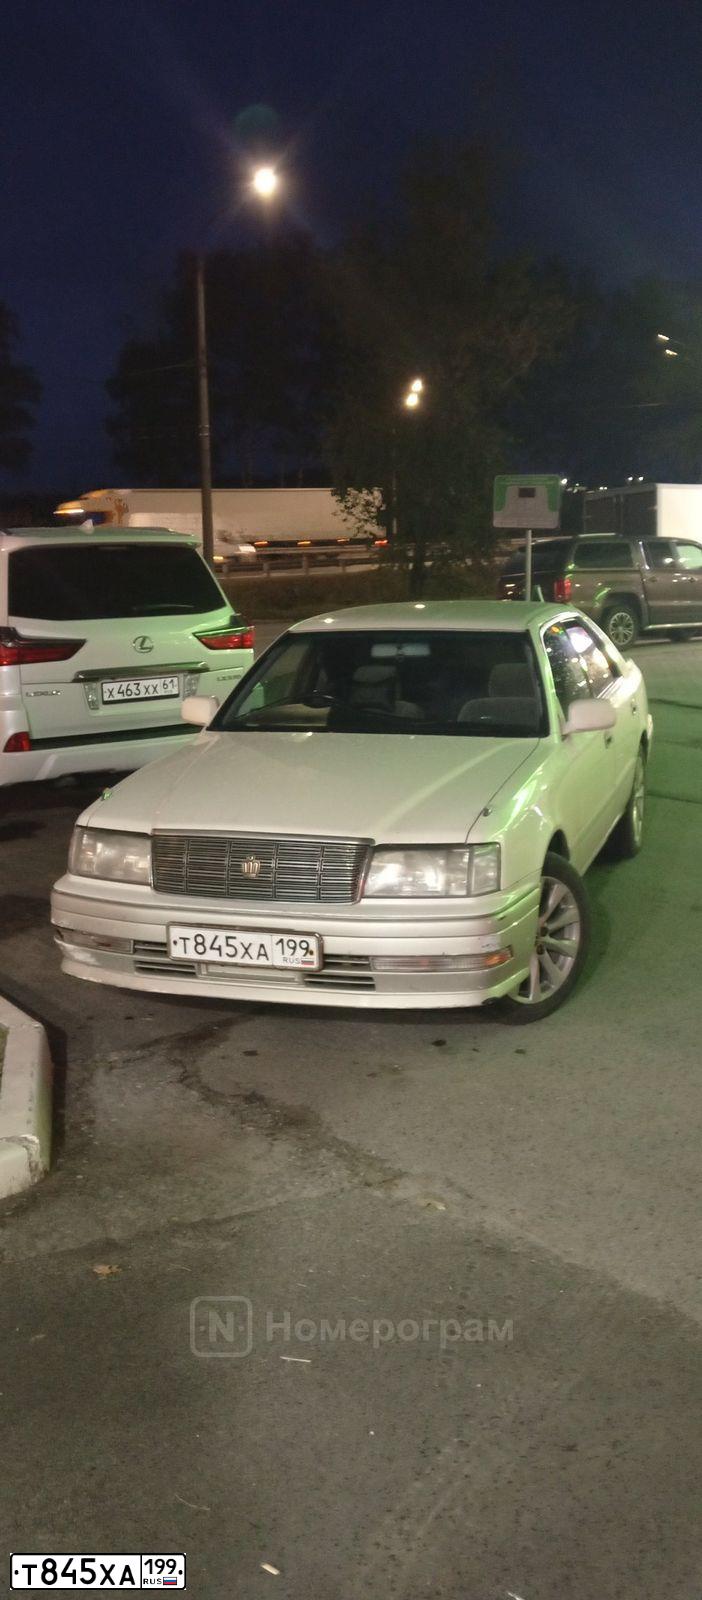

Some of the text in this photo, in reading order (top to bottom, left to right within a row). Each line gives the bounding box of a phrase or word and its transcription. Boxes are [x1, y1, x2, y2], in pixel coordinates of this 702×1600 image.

[162, 679, 174, 690] 61
[179, 933, 310, 961] Т845ХА 199
[282, 956, 300, 964] RUS
